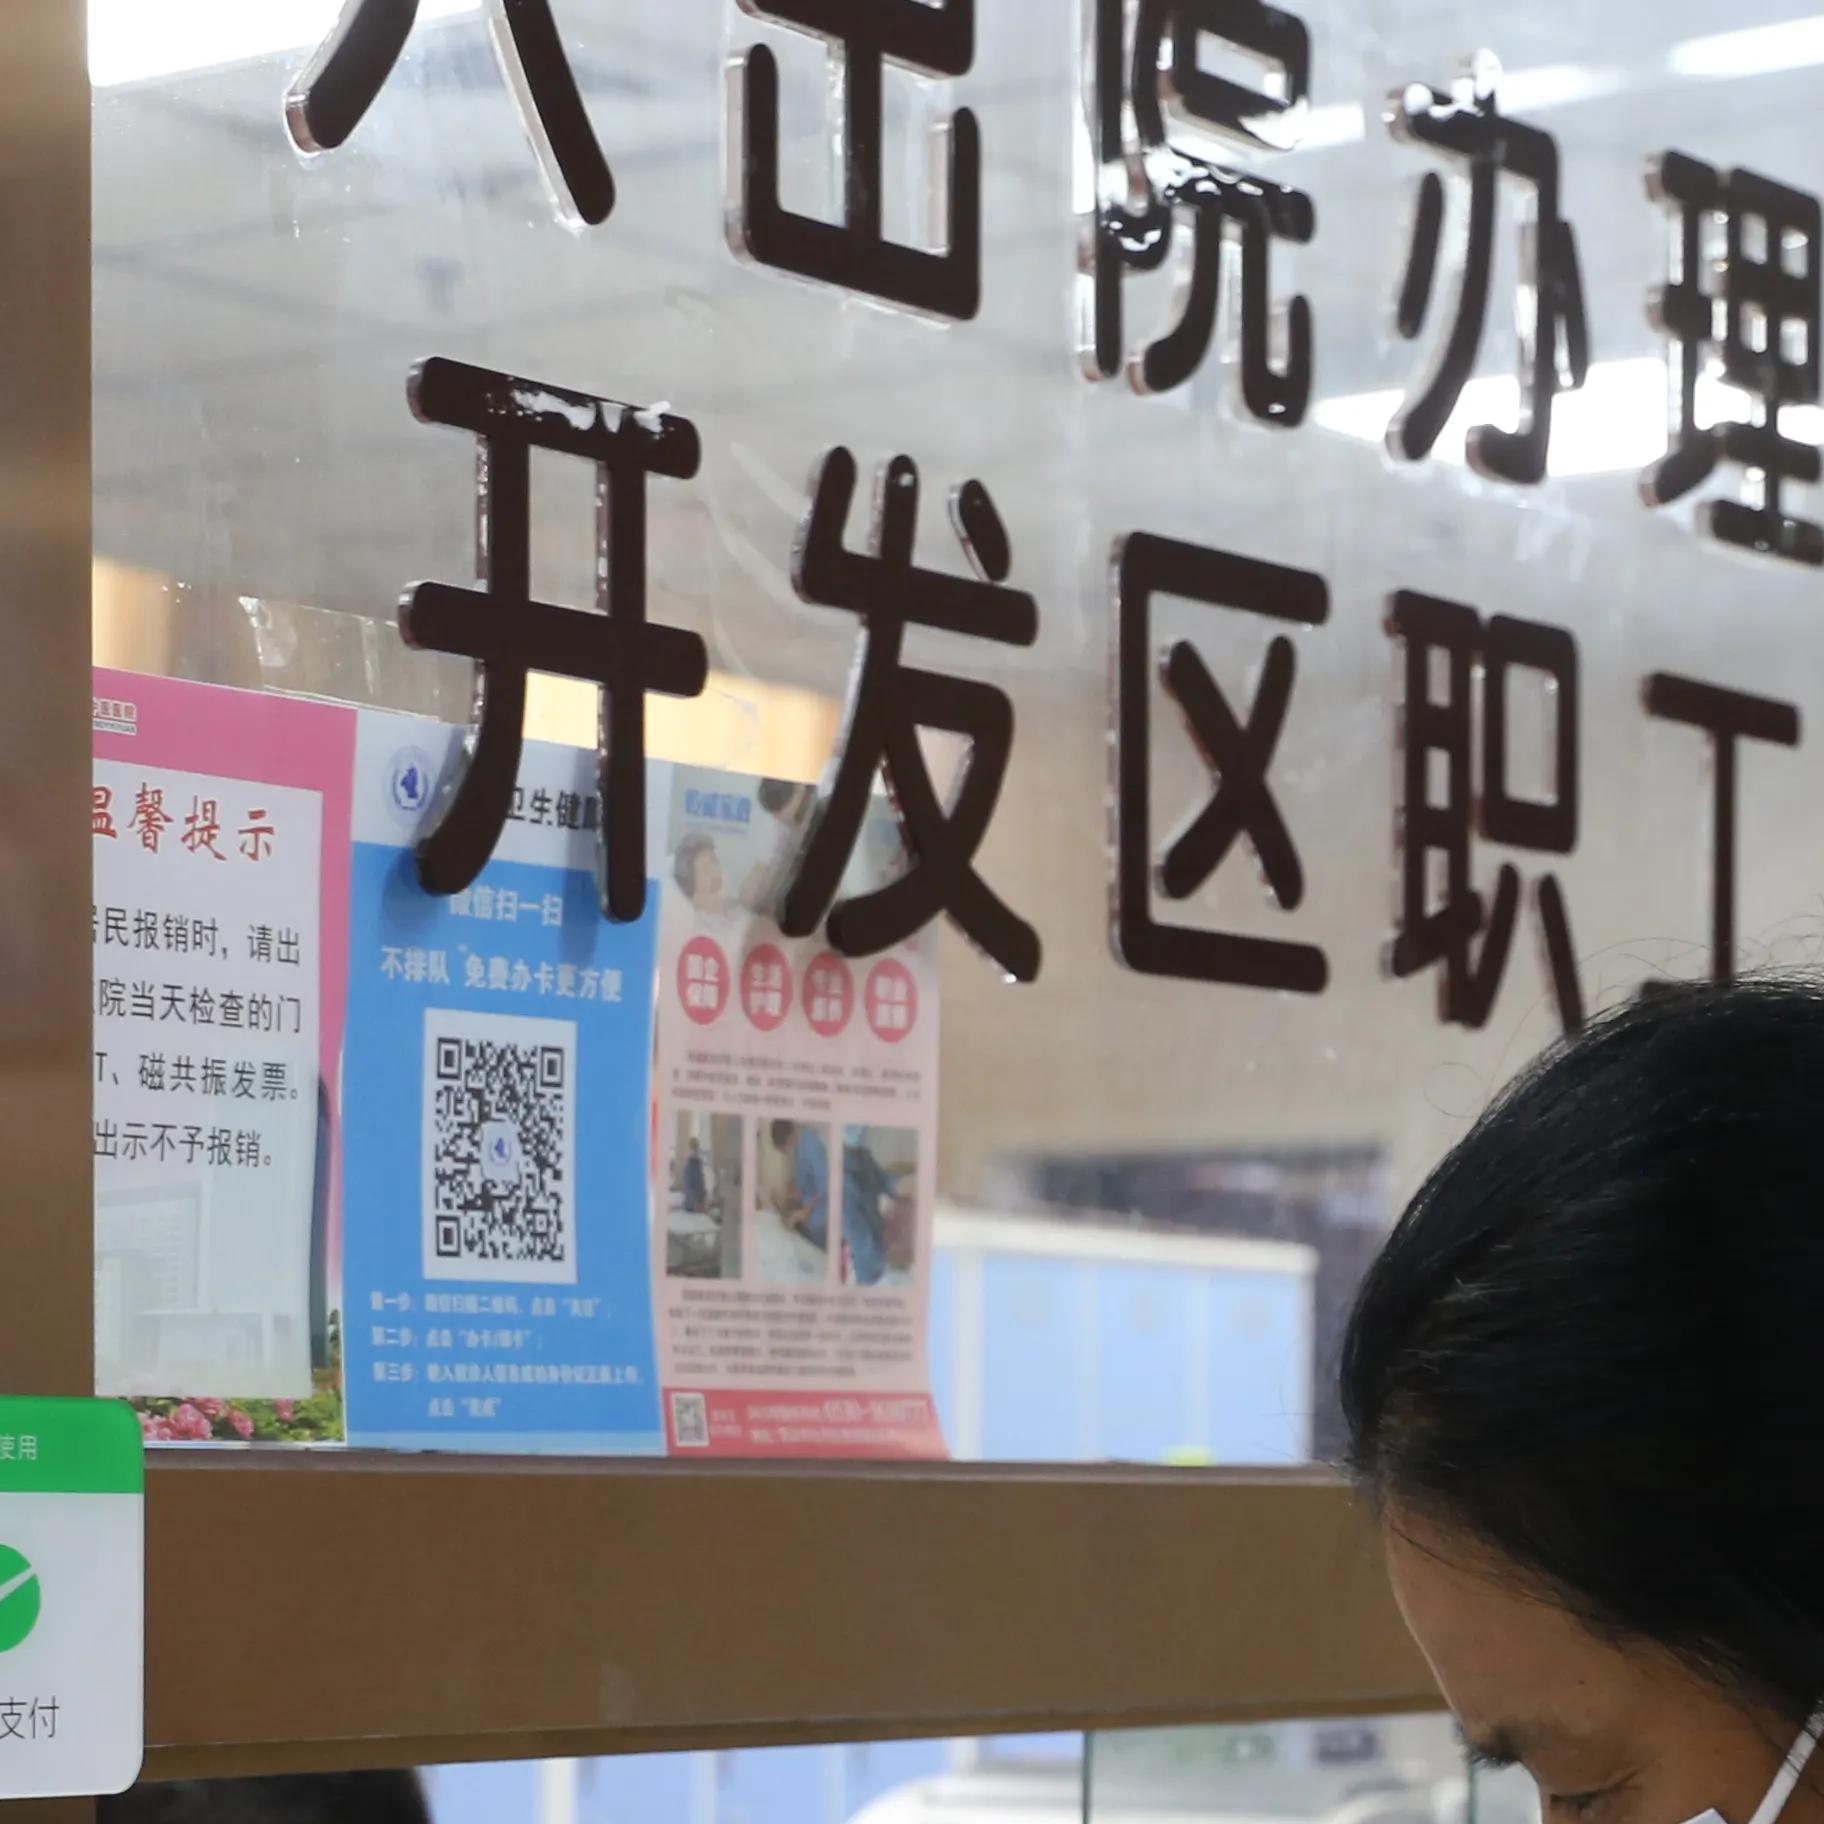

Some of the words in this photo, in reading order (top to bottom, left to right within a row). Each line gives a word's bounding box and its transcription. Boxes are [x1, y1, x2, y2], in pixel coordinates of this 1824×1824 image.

[93, 977, 302, 1035] 院当天检查的门
[94, 1118, 273, 1169] 出示不予报销。
